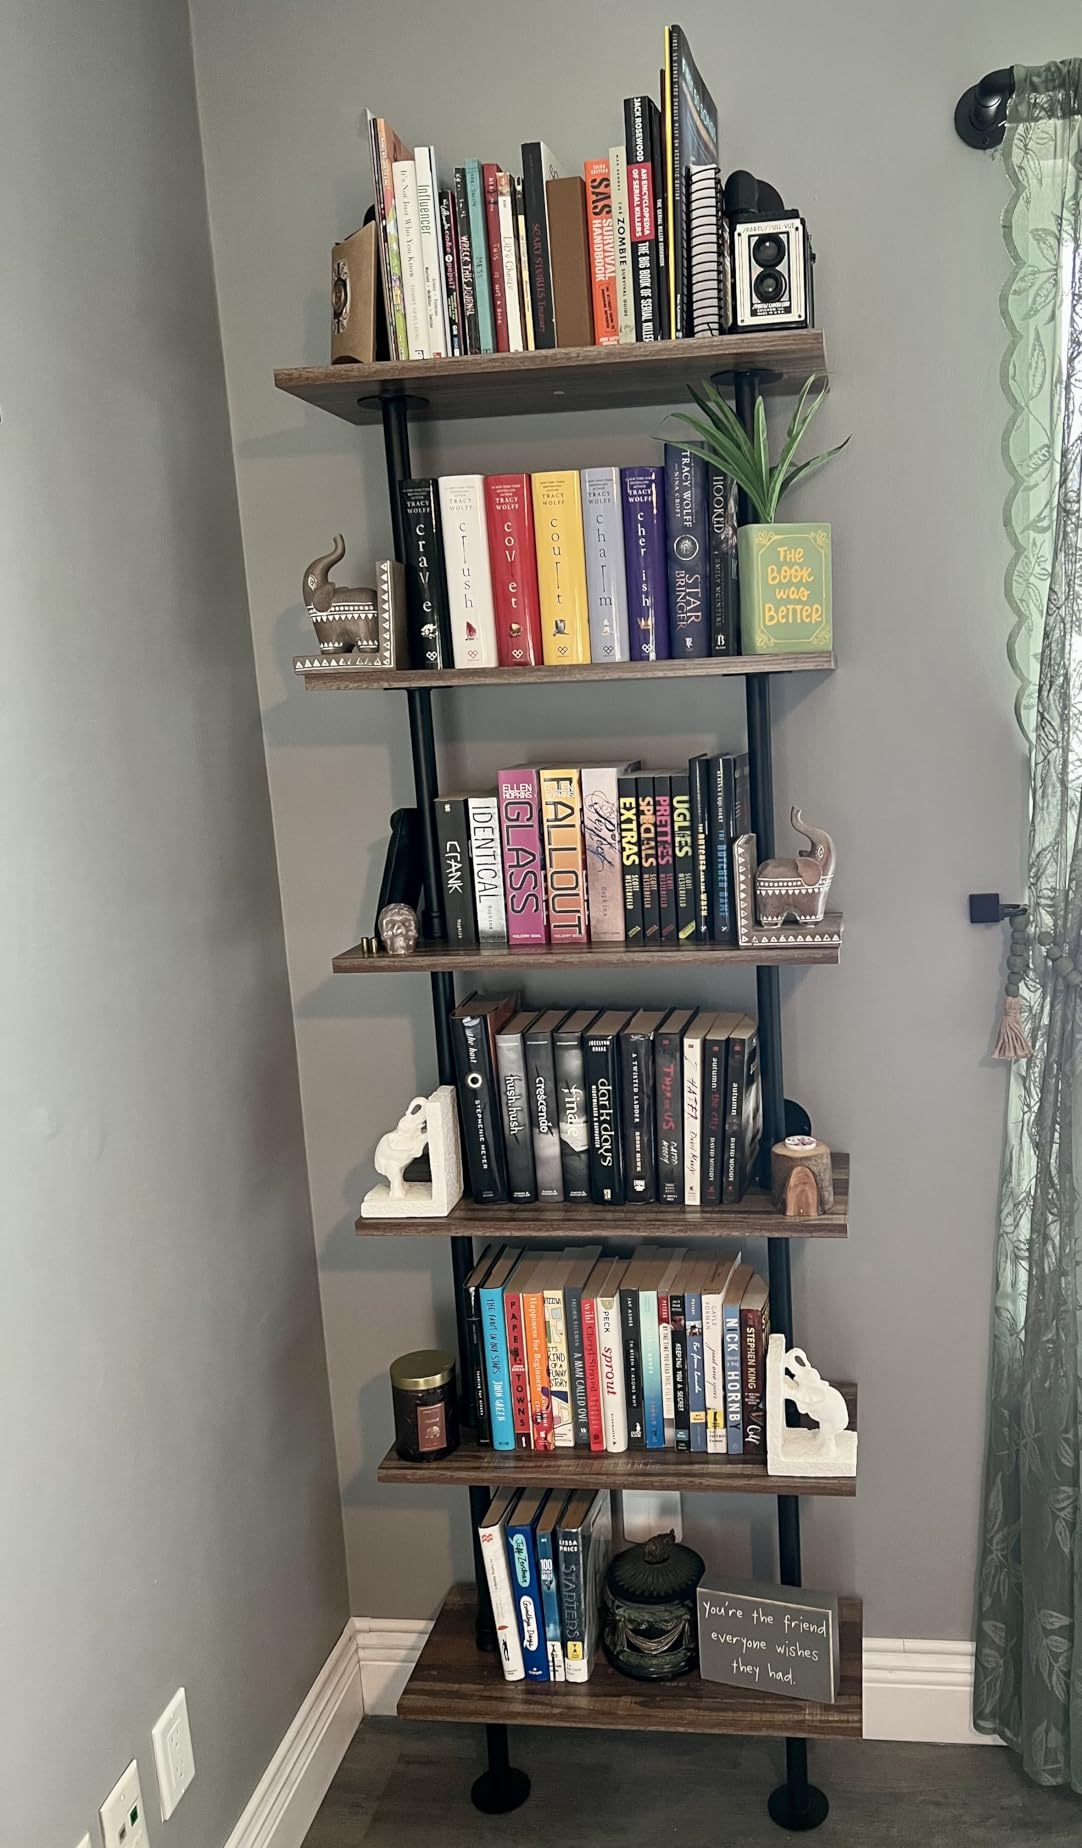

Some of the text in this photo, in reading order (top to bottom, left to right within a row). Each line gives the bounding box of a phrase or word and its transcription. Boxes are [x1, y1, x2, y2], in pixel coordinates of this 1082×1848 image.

[634, 98, 644, 162] JACK ROSEWOOD
[400, 170, 408, 182] It's
[402, 185, 410, 198] Not
[632, 168, 640, 179] OF
[417, 184, 431, 235] Influencer
[591, 177, 612, 217] SAS
[641, 168, 650, 236] AN ENCYCLOPEDIA
[634, 206, 642, 237] KILLERS
[592, 220, 605, 282] HANDBOOK
[603, 218, 616, 280] SURVIVAL
[617, 217, 627, 266] ZOMBIE
[638, 241, 649, 255] THE
[446, 262, 455, 289] pepsi?
[461, 235, 475, 316] WRECK THIS JOURNAL
[532, 223, 546, 333] SCARY STORIES Treasury
[638, 256, 650, 268] BIG
[640, 269, 650, 288] BOOK
[640, 288, 651, 298] OF
[641, 298, 652, 321] SERIAL
[495, 503, 519, 511] WOLFF
[628, 488, 652, 496] TRACY
[681, 449, 693, 528] TRACY WOLFF
[711, 475, 724, 534] HOOKED
[415, 523, 433, 613] crave
[458, 522, 474, 609] crush
[503, 521, 519, 609] covet
[550, 518, 563, 605] court
[595, 514, 613, 607] charm
[637, 511, 650, 607] cherish
[767, 564, 815, 585] BOOK
[675, 570, 687, 632] BRINGER
[686, 574, 702, 625] STAR
[774, 587, 811, 601] was
[502, 783, 533, 792] ELLEN
[503, 791, 533, 800] HOPKINS
[619, 796, 639, 866] EXTRAS
[639, 796, 656, 868] SPECIALS
[656, 795, 672, 865] PRETTIES
[672, 795, 691, 858] UGLIES
[445, 841, 464, 894] CRANK
[471, 805, 499, 904] IDENTICAL
[503, 799, 540, 915] GLASS
[543, 776, 583, 938] FALLOUT
[717, 844, 728, 888] BUTCHER
[625, 874, 634, 910] WESTERFELD
[632, 874, 640, 891] SCOTT
[643, 874, 652, 909] WESTERFELD
[650, 873, 658, 890] SCOTT
[660, 873, 668, 908] WESTERFELD
[678, 873, 687, 908] WESTERFELD
[685, 873, 693, 889] SCOTT
[700, 893, 708, 916] WREN
[719, 891, 728, 918] GAME
[467, 1033, 478, 1063] the host
[505, 1076, 526, 1135] hush, hush
[535, 1076, 553, 1133] crescendo
[561, 1084, 584, 1137] finale
[686, 1078, 698, 1121] HATER
[474, 1100, 488, 1169] STEPHENIE MEYER
[598, 1078, 615, 1167] dark days
[661, 1139, 669, 1164] MOODY
[486, 1299, 495, 1310] THE
[602, 1311, 610, 1333] PECK
[490, 1333, 498, 1341] IN
[510, 1301, 523, 1364] PAPER
[528, 1297, 543, 1394] Happiness for Beginners
[586, 1325, 597, 1356] Cheryl
[726, 1318, 739, 1351] NICK
[746, 1327, 757, 1366] STEPHEN
[491, 1356, 501, 1375] STARS
[574, 1360, 584, 1378] MAN
[587, 1358, 598, 1392] Strayed
[602, 1346, 617, 1396] sprout
[675, 1343, 683, 1369] KEEPING
[576, 1379, 587, 1406] CALLED
[747, 1367, 757, 1390] KING
[493, 1380, 506, 1422] JOHN GREEN
[515, 1374, 525, 1427] TOWNS
[578, 1408, 588, 1422] OVE
[727, 1370, 742, 1430] HORNBY
[540, 1559, 553, 1570] 100
[561, 1564, 580, 1639] STARTERS
[703, 1600, 827, 1638] You're the friend
[522, 1600, 536, 1649] Goodbye Days
[711, 1631, 819, 1662] everyone wishes
[731, 1657, 797, 1686] they had.
